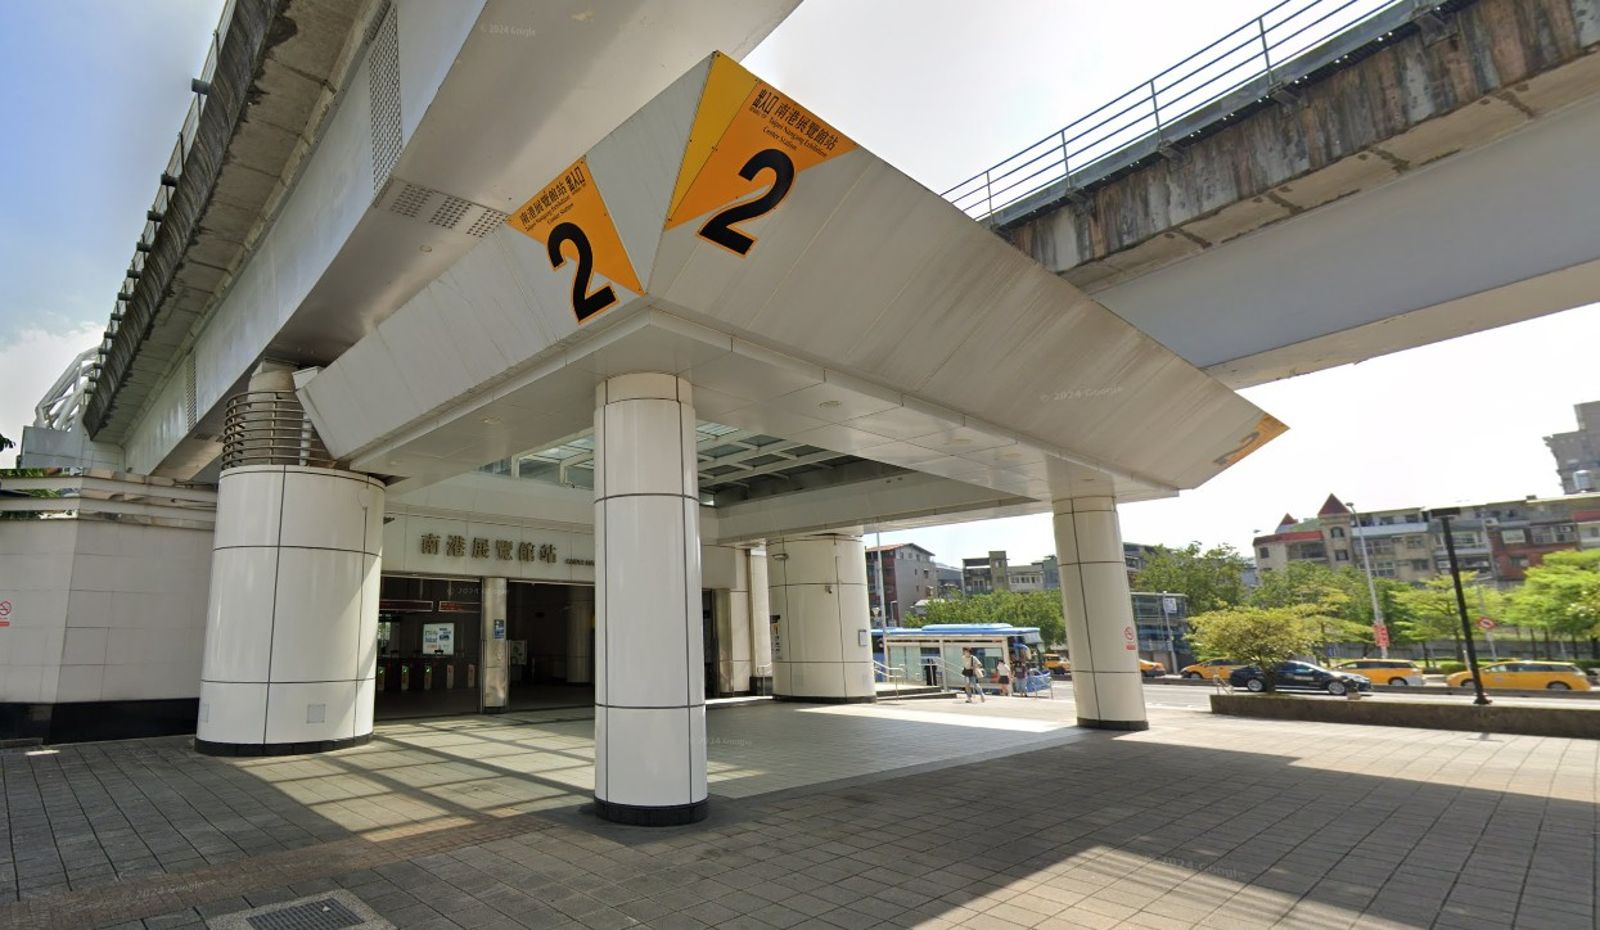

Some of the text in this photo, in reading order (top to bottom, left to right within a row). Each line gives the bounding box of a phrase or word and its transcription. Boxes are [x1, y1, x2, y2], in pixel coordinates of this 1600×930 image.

[774, 102, 839, 151] 南港展覽館站
[700, 148, 795, 256] 2
[548, 222, 616, 322] 2
[420, 533, 558, 564] 南港展覽館站
